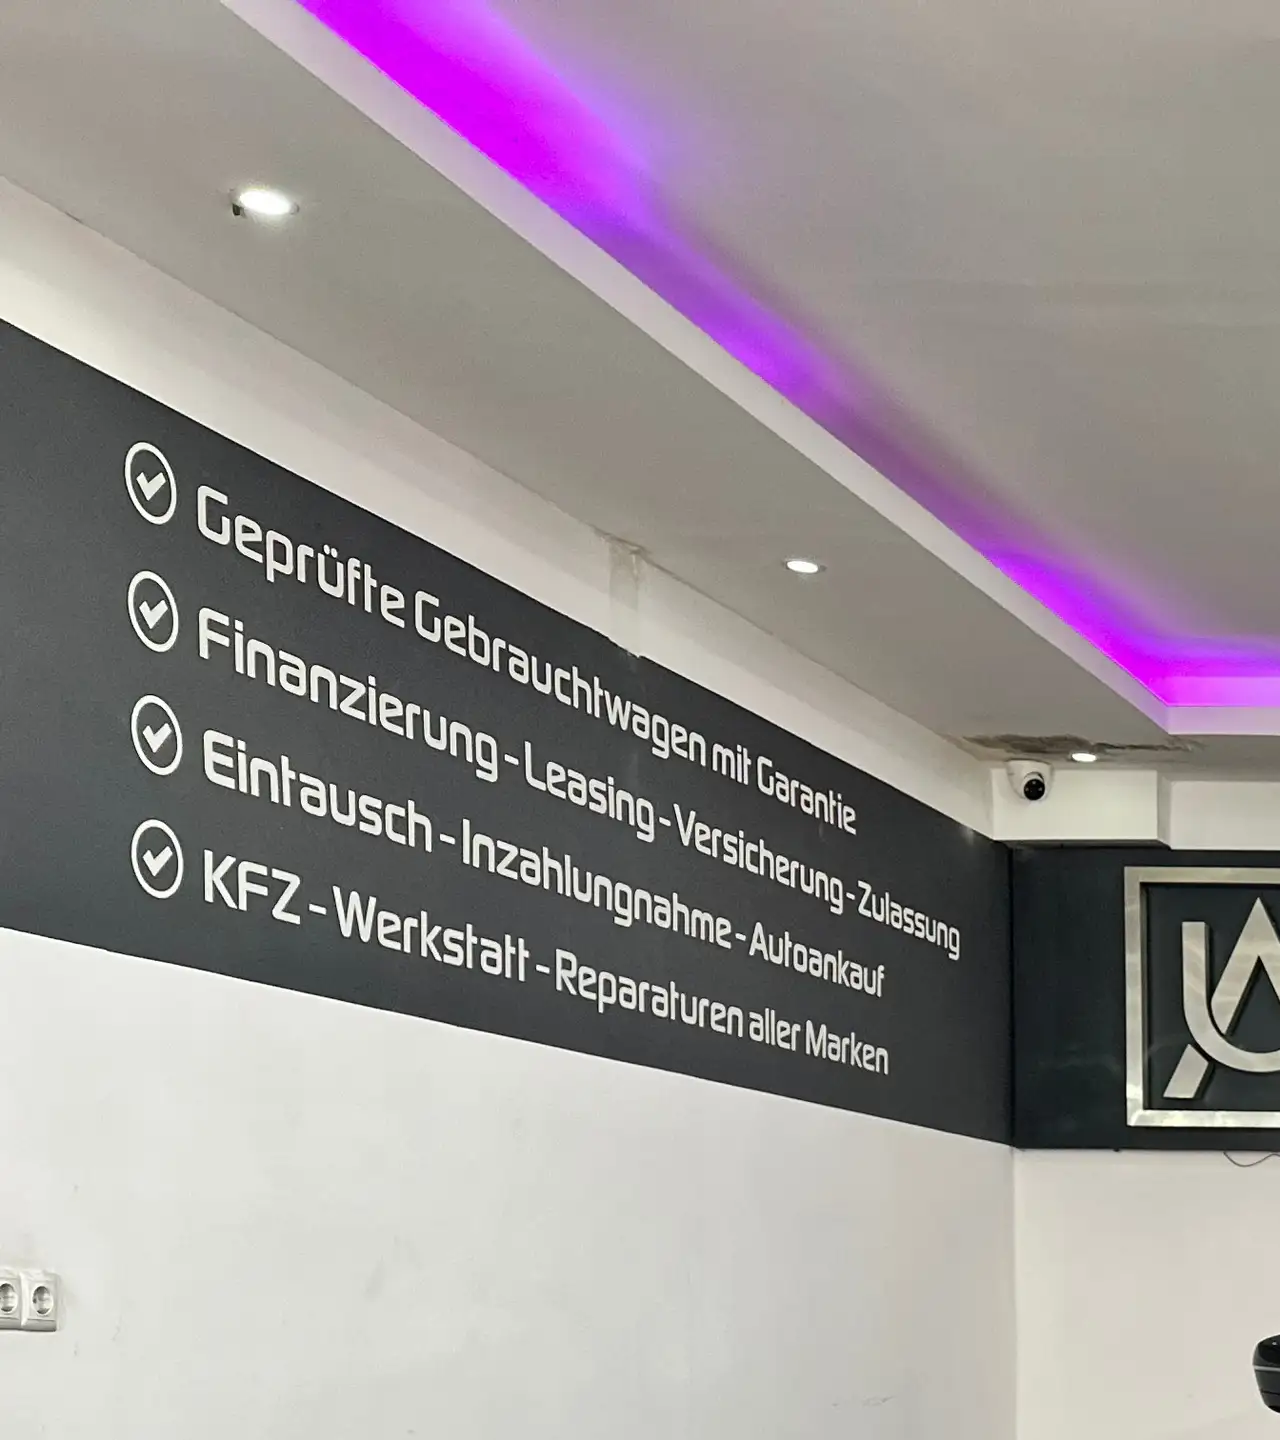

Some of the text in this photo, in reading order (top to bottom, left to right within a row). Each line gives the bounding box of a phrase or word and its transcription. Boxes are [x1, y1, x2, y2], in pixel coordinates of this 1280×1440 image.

[197, 485, 857, 835] Geprüfte Gebrauchtwagen mit Garantie
[204, 849, 301, 925] KFZ
[555, 948, 743, 1037] Reparaturen
[749, 1007, 801, 1051] aller
[805, 1020, 889, 1075] Marken
[749, 921, 885, 997] Autoankauf
[857, 880, 960, 961] Zulassung
